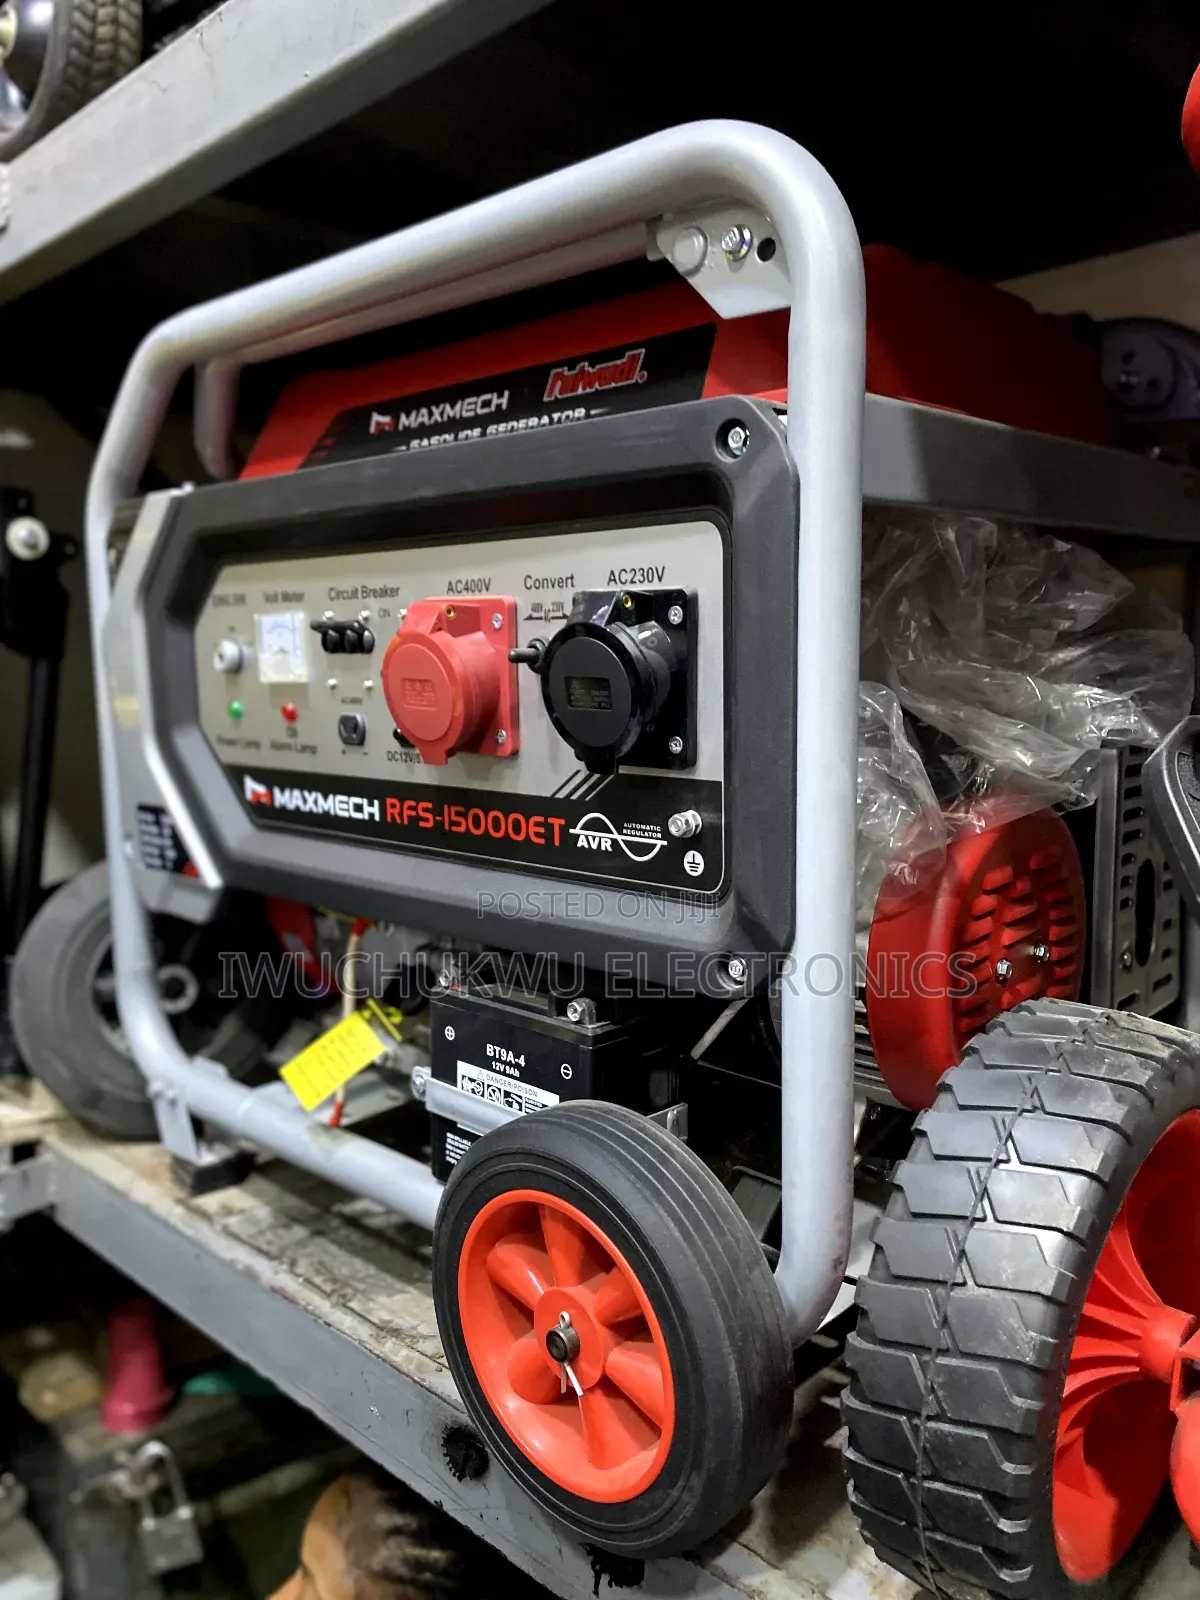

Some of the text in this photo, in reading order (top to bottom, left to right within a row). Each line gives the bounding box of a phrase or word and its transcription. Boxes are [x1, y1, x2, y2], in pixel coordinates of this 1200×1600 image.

[398, 389, 509, 431] MAXMECH
[486, 407, 586, 435] GENERATOR
[524, 573, 575, 590] Convert
[607, 566, 665, 586] AC230V
[328, 584, 400, 601] Circuit Breaker
[447, 578, 491, 594] AC400V
[273, 785, 566, 847] MAXMECH RFS-15000ET
[622, 828, 662, 839] REGULATOR
[623, 822, 661, 832] AUTOMATIC
[576, 834, 613, 852] AVR
[486, 1043, 526, 1067] BT9A-4
[491, 1060, 520, 1078] 12V 9Ah
[485, 1073, 538, 1098] DANGER/POISON
